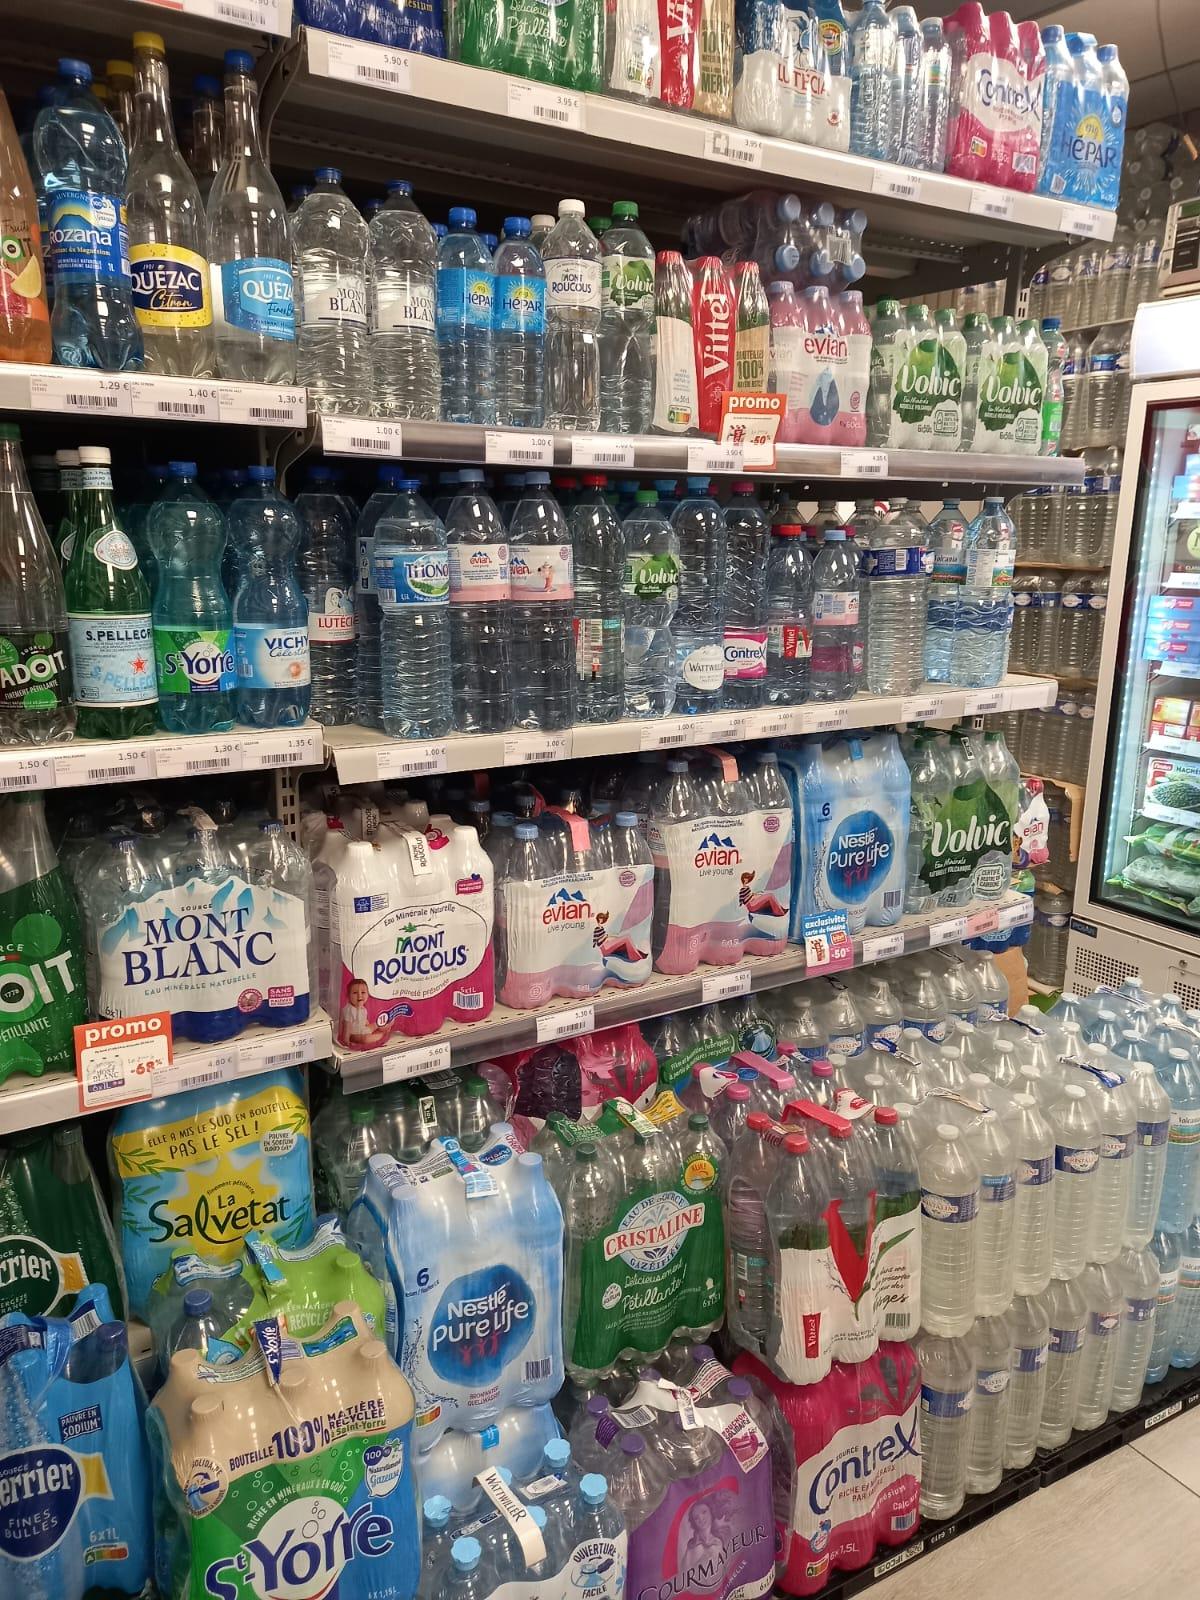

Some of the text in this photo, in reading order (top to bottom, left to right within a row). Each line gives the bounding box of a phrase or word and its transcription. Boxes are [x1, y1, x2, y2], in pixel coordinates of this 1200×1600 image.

[552, 282, 592, 294] ROUCOUS
[703, 293, 729, 379] Vittel
[804, 335, 848, 357] evian
[100, 381, 120, 390] 1,29
[900, 364, 962, 398] Volvic
[987, 374, 1042, 406] Volvic
[189, 389, 208, 398] 1,40
[210, 390, 216, 398] €
[278, 395, 297, 403] 1,30
[729, 396, 781, 412] promo
[639, 568, 678, 584] Volvic
[264, 637, 308, 650] VICHY
[786, 629, 795, 651] Vittel
[288, 739, 304, 747] 1,35
[19, 761, 40, 769] 1,50
[822, 803, 830, 817] 6
[932, 815, 1010, 857] Volvic
[694, 847, 740, 869] evian
[712, 868, 733, 876] young
[181, 904, 212, 912] SOURCE
[396, 909, 427, 922] Minérale
[542, 902, 591, 924] evian
[144, 908, 249, 946] MONT
[561, 921, 585, 932] young
[805, 915, 846, 928] exclusivité
[396, 931, 445, 954] MONT
[122, 932, 277, 986] BLANC
[373, 945, 467, 986] ROUCOUS
[145, 986, 161, 996] EAU
[210, 973, 257, 990] NATURELLE
[85, 1017, 162, 1047] promo
[148, 1135, 168, 1148] ELLE
[179, 1127, 194, 1138] MIS
[197, 1124, 207, 1134] LE
[209, 1114, 231, 1130] SUD
[236, 1112, 246, 1121] EN
[170, 1142, 197, 1159] PAS
[203, 1135, 219, 1151] LE
[225, 1125, 250, 1142] SEL
[218, 1194, 235, 1208] La
[149, 1194, 290, 1244] Salvetat
[622, 1212, 638, 1228] EAU
[639, 1198, 655, 1211] DE
[606, 1206, 704, 1256] CRISTALINE
[417, 1267, 429, 1287] 6
[624, 1261, 683, 1289] Délicieusement
[448, 1283, 510, 1321] Nestlé
[433, 1298, 529, 1352] Pure Life
[61, 1408, 97, 1426] PAUVRE EN
[327, 1398, 385, 1422] MATIÈRE
[329, 1407, 385, 1430] RECYCLÉE
[229, 1415, 331, 1472] BOUTEILLE 100%
[835, 1446, 860, 1461] SOURCE
[485, 1472, 528, 1523] WATTWILLER
[838, 1485, 861, 1500] RICHE
[852, 1493, 866, 1502] PAR
[247, 1508, 268, 1530] RICHE
[266, 1497, 278, 1509] EN
[321, 1481, 330, 1489] EN
[5, 1516, 58, 1540] BULLES
[9, 1509, 52, 1529] FINES
[573, 1543, 617, 1563] OUVERTURE
[638, 1524, 768, 1600] COURMAYEUR
[582, 1585, 607, 1599] FACILE
